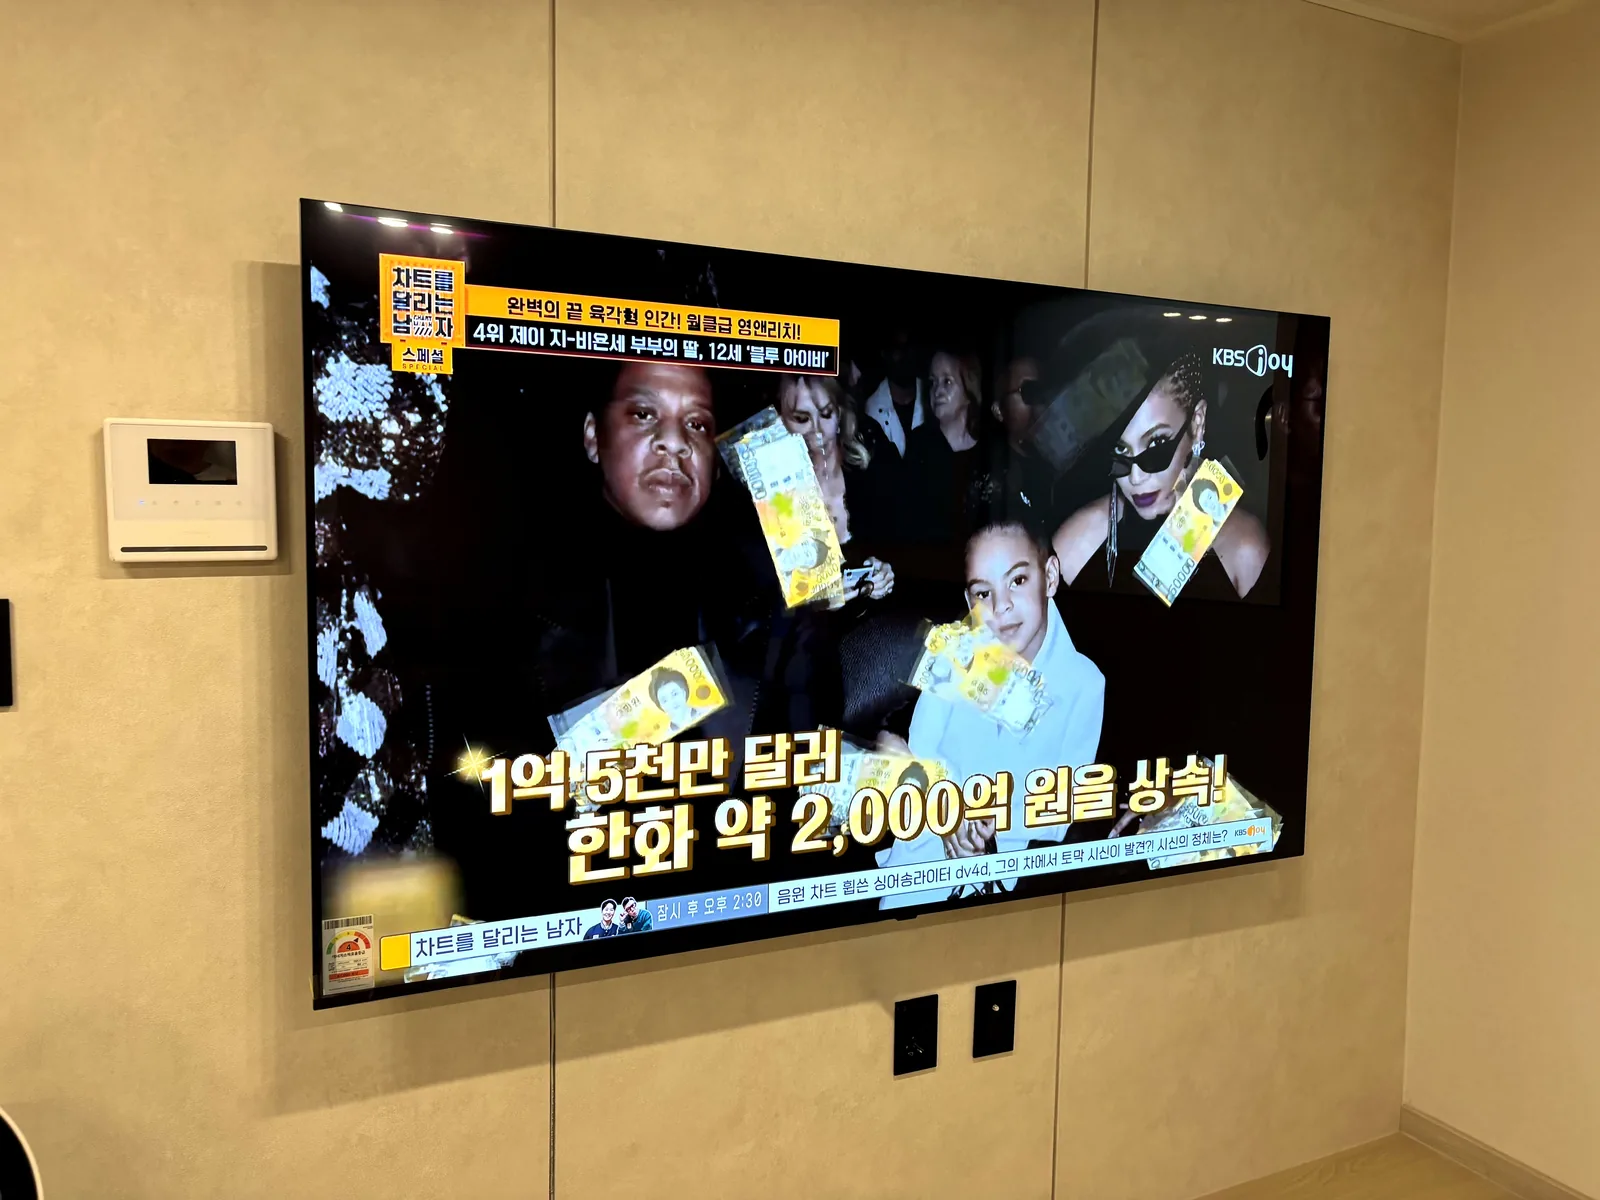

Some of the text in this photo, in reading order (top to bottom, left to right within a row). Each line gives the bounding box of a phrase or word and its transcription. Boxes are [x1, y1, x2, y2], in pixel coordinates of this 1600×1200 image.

[392, 267, 453, 292] 차트를
[392, 290, 453, 316] 달리는
[507, 296, 801, 340] 완벽의 끝 육각형 인간! 월클급 영앤리치!
[402, 347, 444, 364] 스페셜
[472, 322, 830, 369] 4위 제이 지-비욘세 부부의 딸, 12세 '블루 아이비'
[1212, 347, 1245, 367] KBS
[402, 363, 444, 371] SPECIAL
[480, 728, 843, 816] 1억 5천만 달러
[565, 753, 1228, 885] 한화 약 2,000억 원을 상속!
[777, 829, 1228, 905] 음원 차트 휩쓴 싱어송라이터 dv4d, 그의 차에서 토막 시신이 발견?! 시신의 정체는?
[657, 891, 762, 922] 잠시 후 오후 2:30
[415, 917, 582, 958] 차트를 달리는 남자
